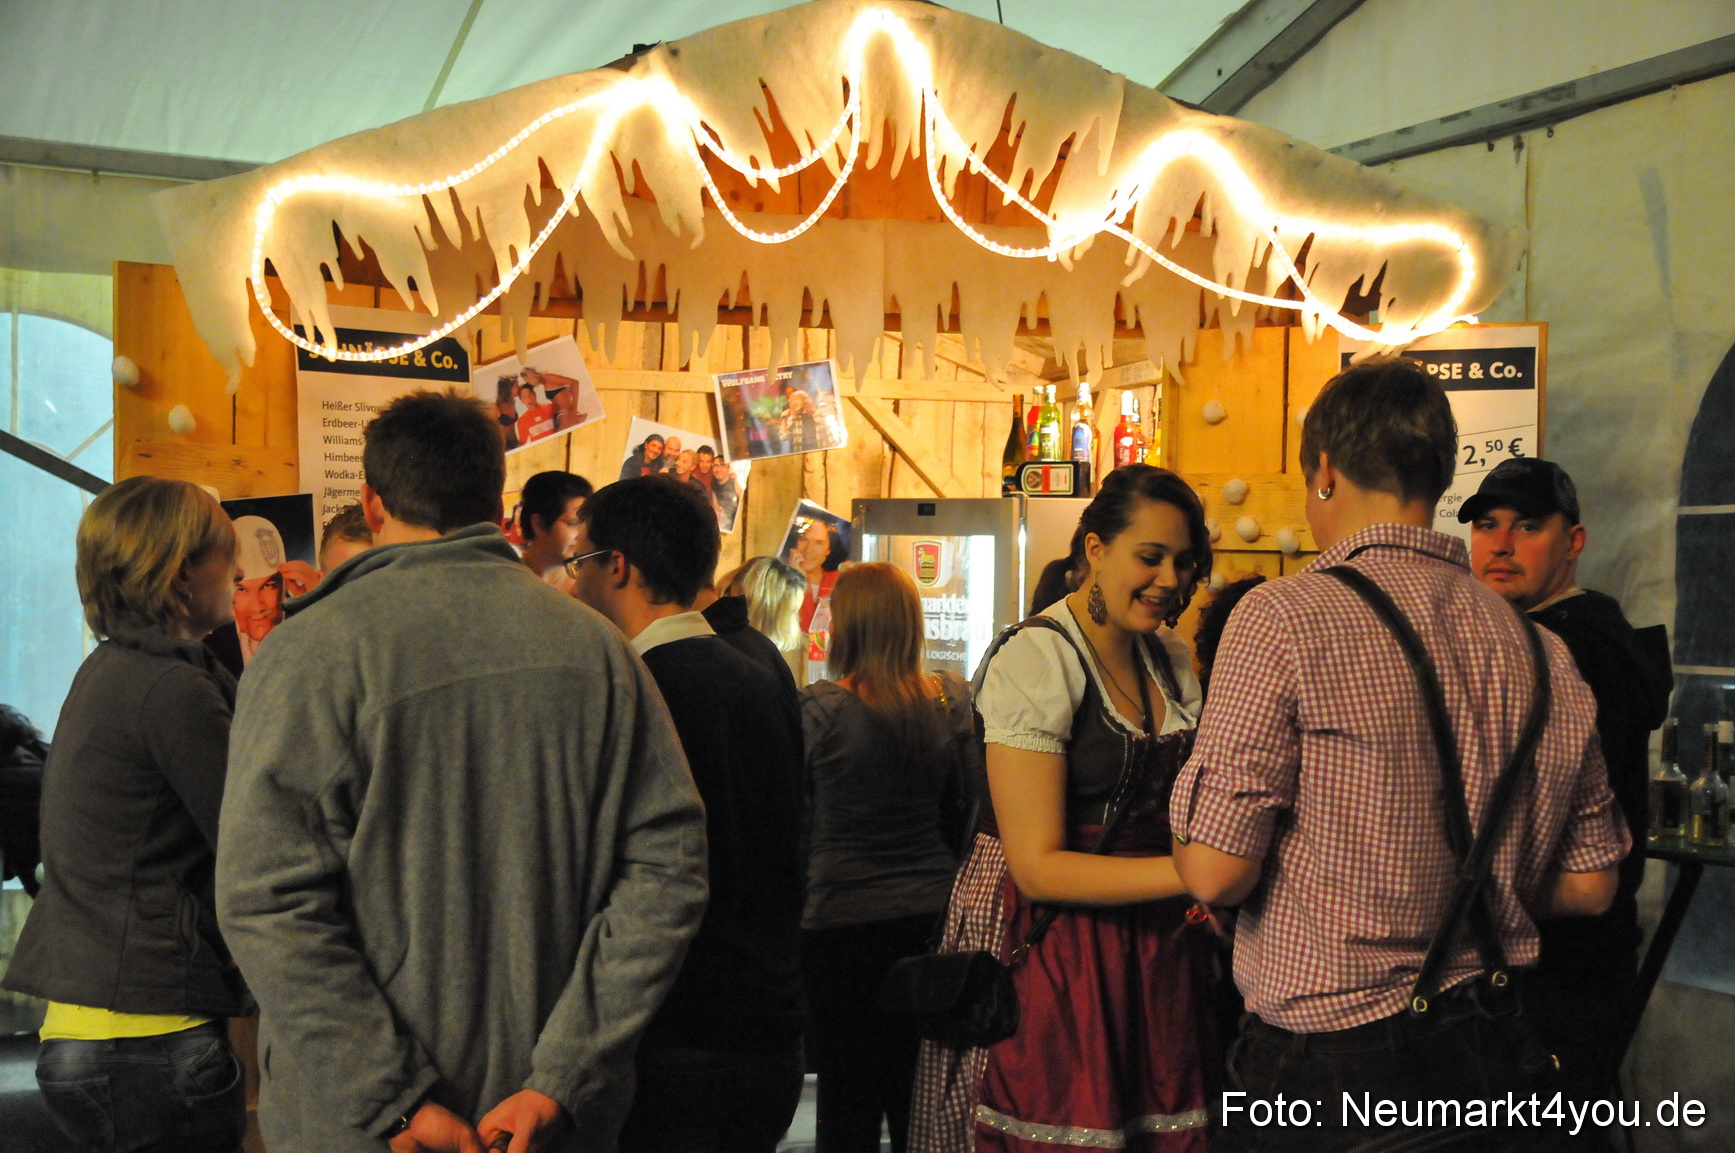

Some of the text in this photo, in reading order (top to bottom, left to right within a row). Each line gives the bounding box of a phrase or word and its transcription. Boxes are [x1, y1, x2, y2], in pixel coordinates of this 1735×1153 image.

[414, 350, 427, 367] &
[431, 351, 459, 370] Co.
[1468, 362, 1484, 379] &
[1489, 361, 1523, 379] Co.
[322, 400, 352, 411] Heißer
[1507, 437, 1526, 459] €
[324, 469, 366, 480] Wodka-E
[322, 487, 361, 499] Jägerme
[1438, 493, 1463, 505] ergie
